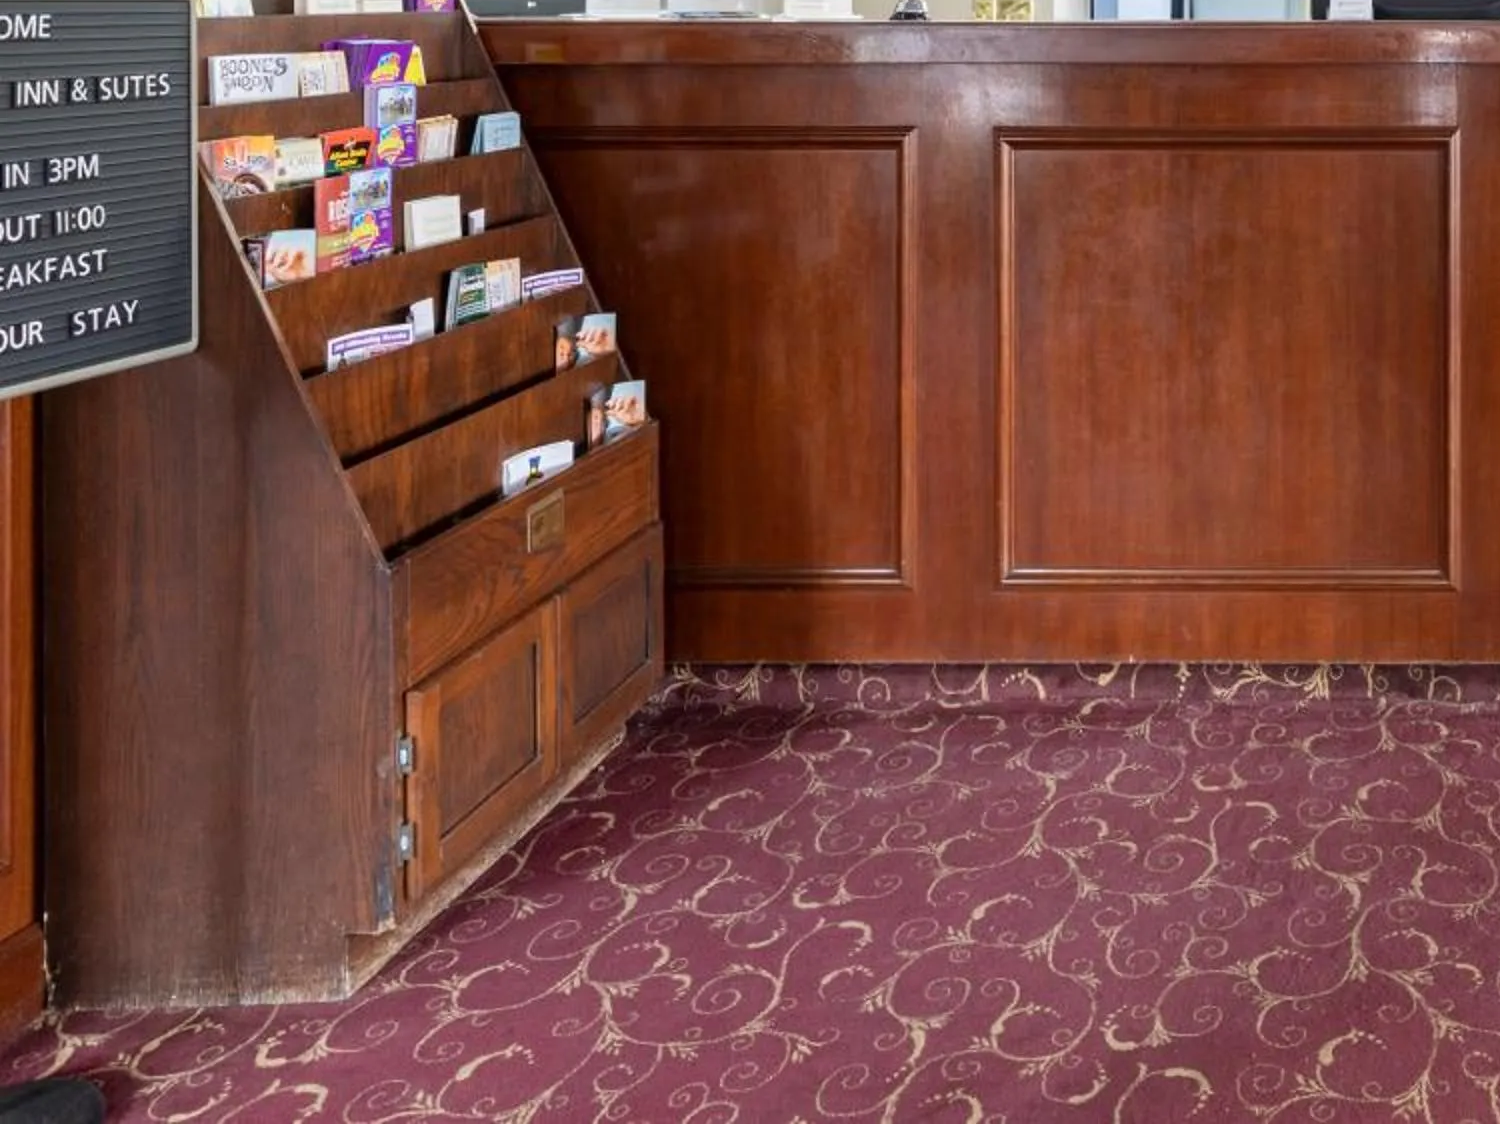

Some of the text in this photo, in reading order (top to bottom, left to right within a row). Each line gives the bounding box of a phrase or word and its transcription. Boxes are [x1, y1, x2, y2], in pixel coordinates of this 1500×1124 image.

[16, 74, 171, 106] INN & SUTES
[4, 154, 100, 188] IN 3PM
[0, 205, 106, 243] UT 11:00
[73, 300, 139, 336] STAY
